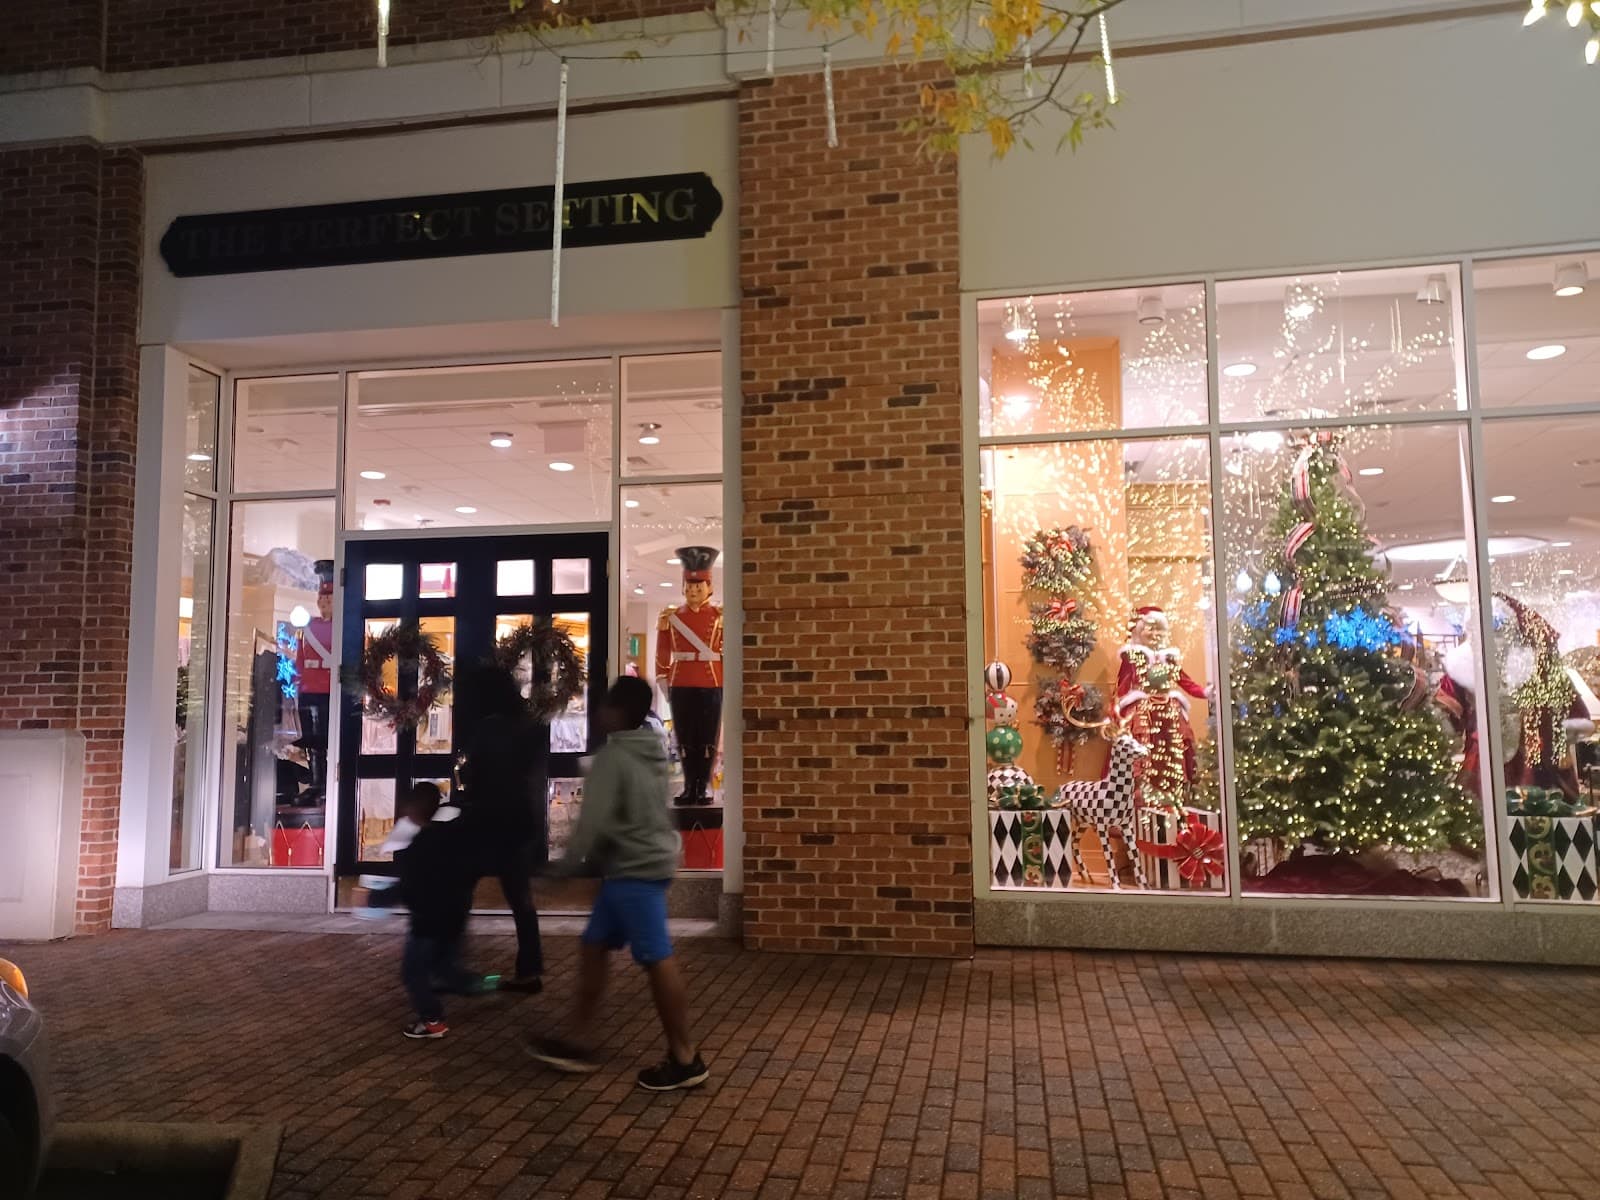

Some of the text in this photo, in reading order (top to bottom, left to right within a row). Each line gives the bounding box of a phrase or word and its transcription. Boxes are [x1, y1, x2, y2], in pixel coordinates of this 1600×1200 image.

[179, 187, 697, 262] THE PERFECT SETTING
